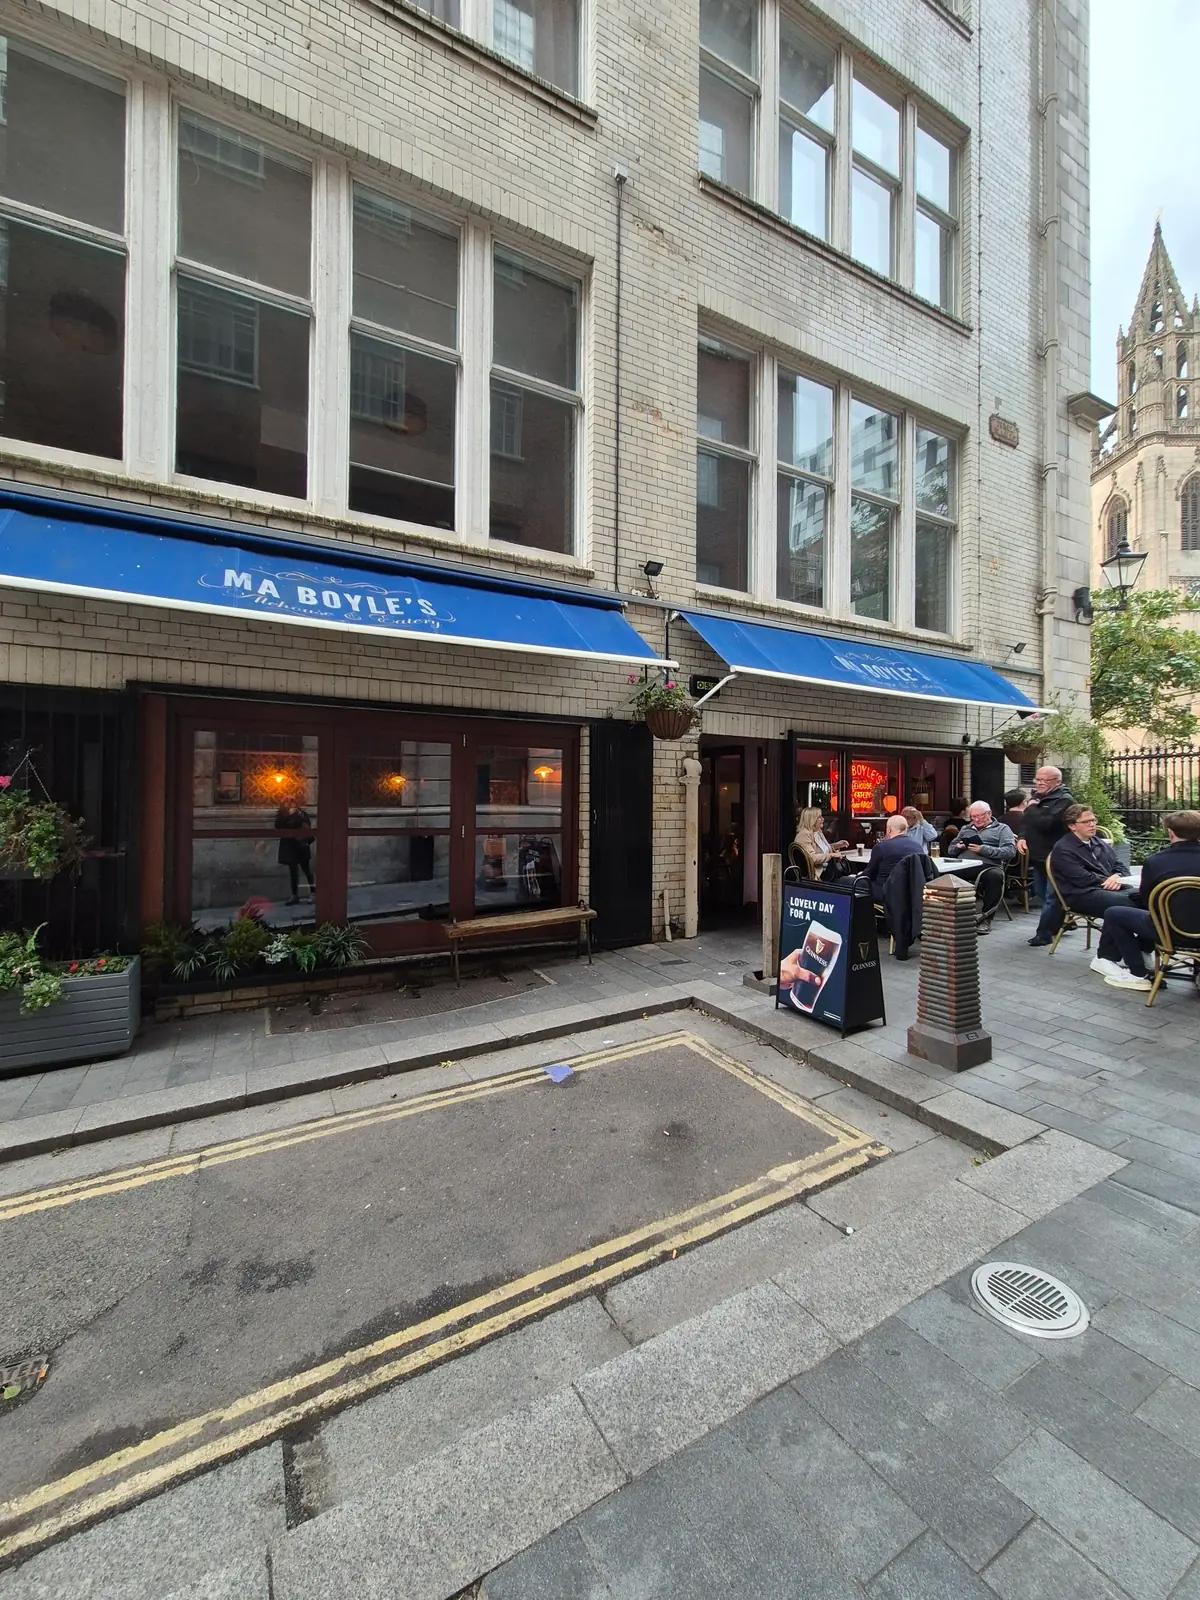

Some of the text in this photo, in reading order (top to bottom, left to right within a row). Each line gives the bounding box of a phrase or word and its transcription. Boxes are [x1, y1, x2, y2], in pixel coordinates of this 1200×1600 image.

[224, 569, 437, 617] MA BOYLE'S
[851, 764, 883, 785] BOYLE'S
[790, 896, 835, 914] LOVELY DAY
[790, 908, 811, 921] FOR A
[805, 945, 828, 967] GUINNESS
[851, 960, 877, 972] GUINNESS
